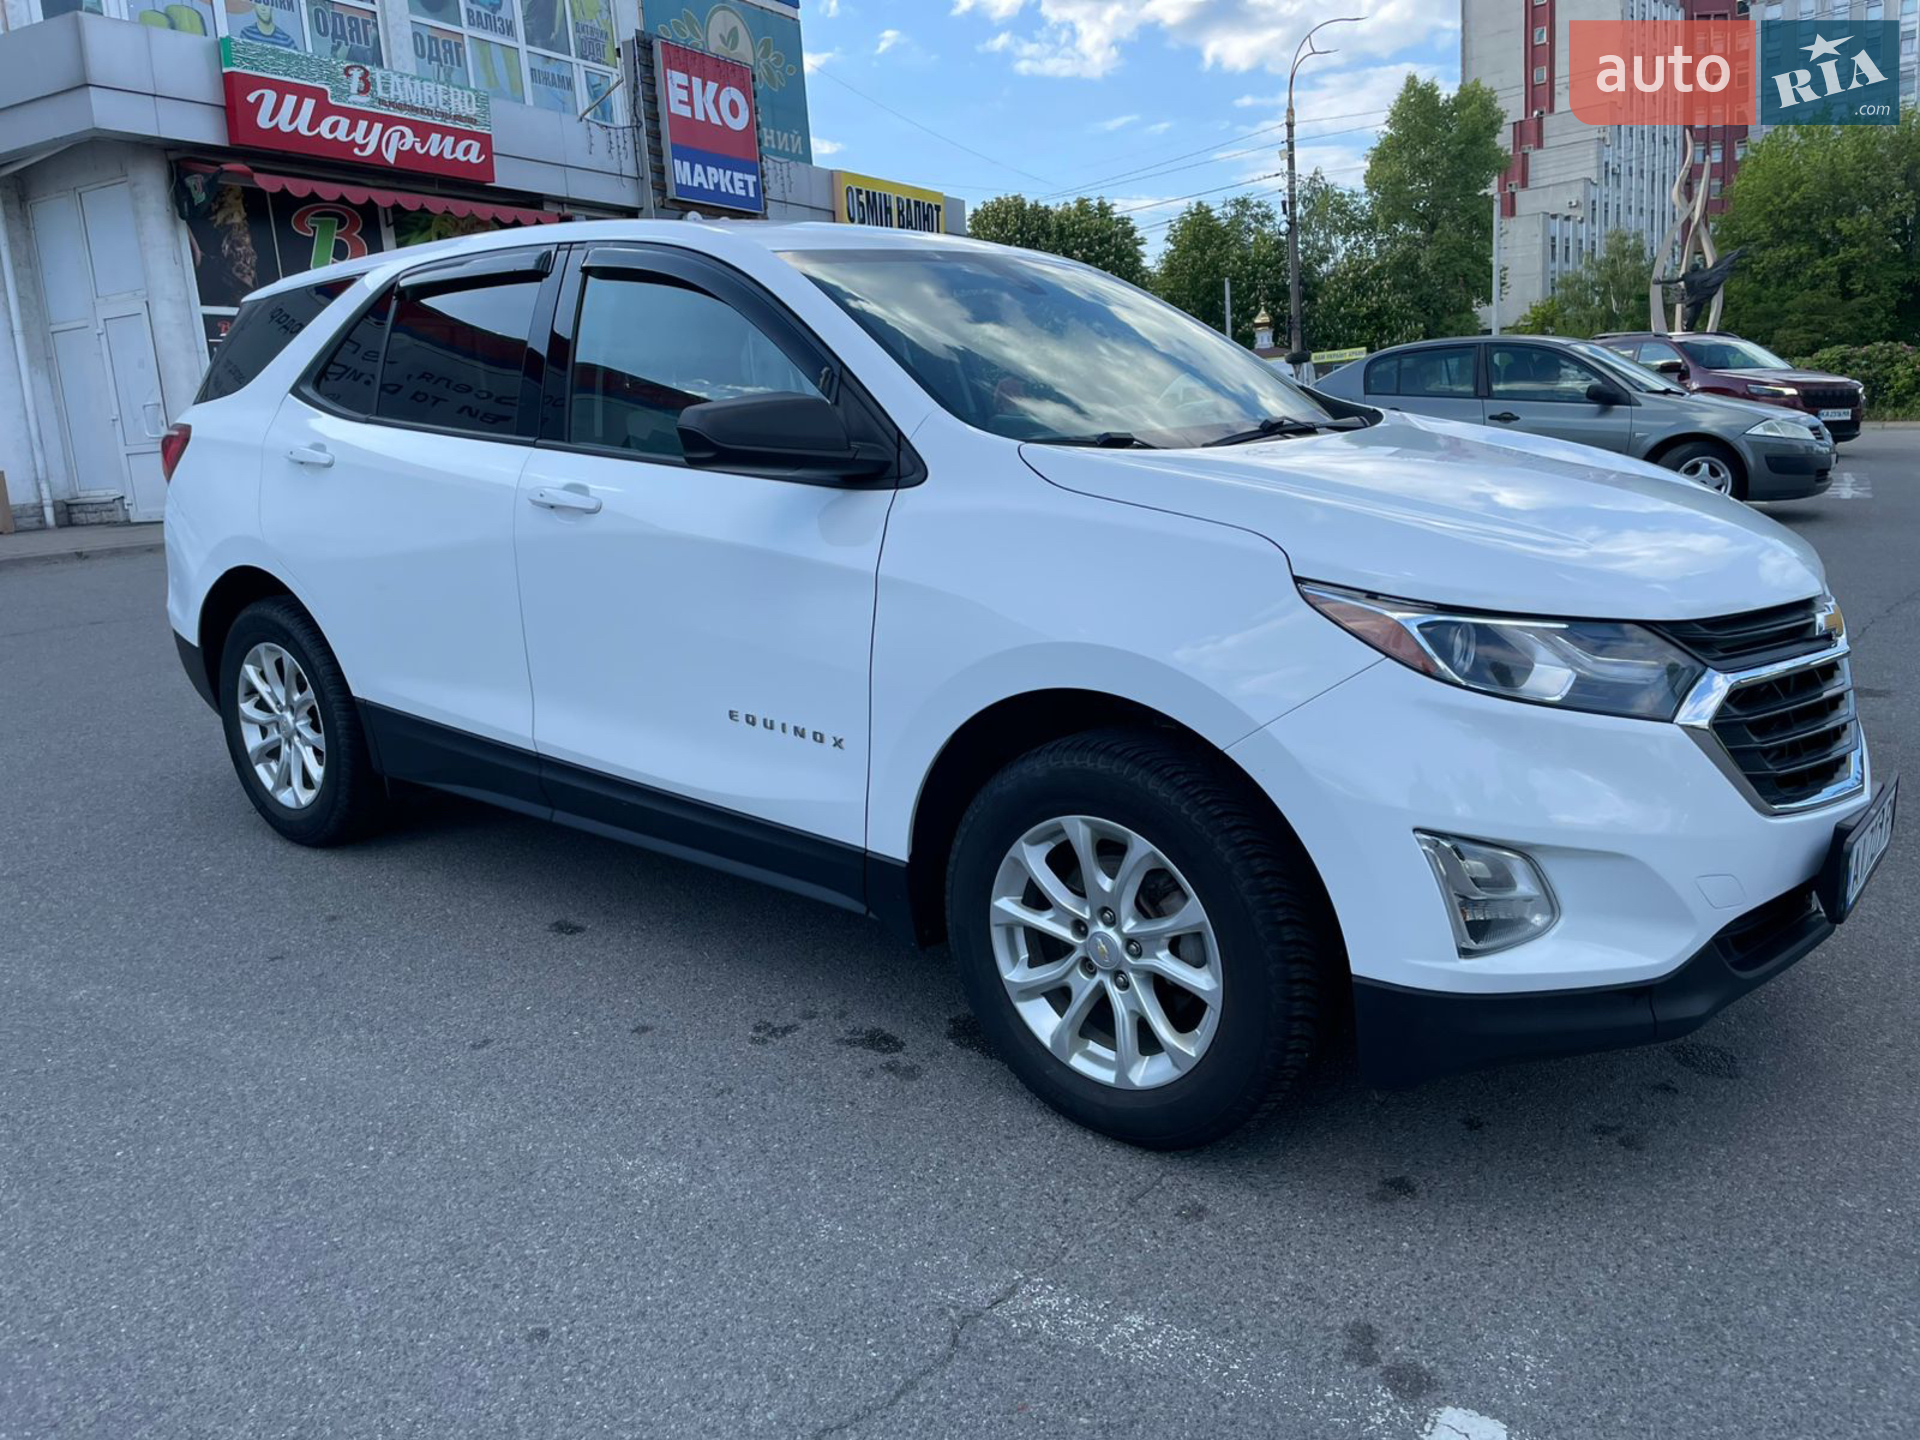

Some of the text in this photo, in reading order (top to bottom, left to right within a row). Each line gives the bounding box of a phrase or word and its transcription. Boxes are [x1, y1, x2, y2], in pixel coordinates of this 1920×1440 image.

[314, 6, 373, 46] ОДЯГ
[466, 8, 514, 37] ВАЛІЗИ
[413, 31, 463, 67] ОДЯГ
[530, 67, 573, 91] ПІЖАМИ
[666, 68, 750, 131] ЕКО
[247, 88, 485, 165] Шаурма
[762, 127, 803, 155] НИЙ
[673, 158, 757, 198] МАРКЕТ
[845, 185, 942, 234] ОБМІН ВАЛЮТ
[728, 709, 845, 750] EQUINOX
